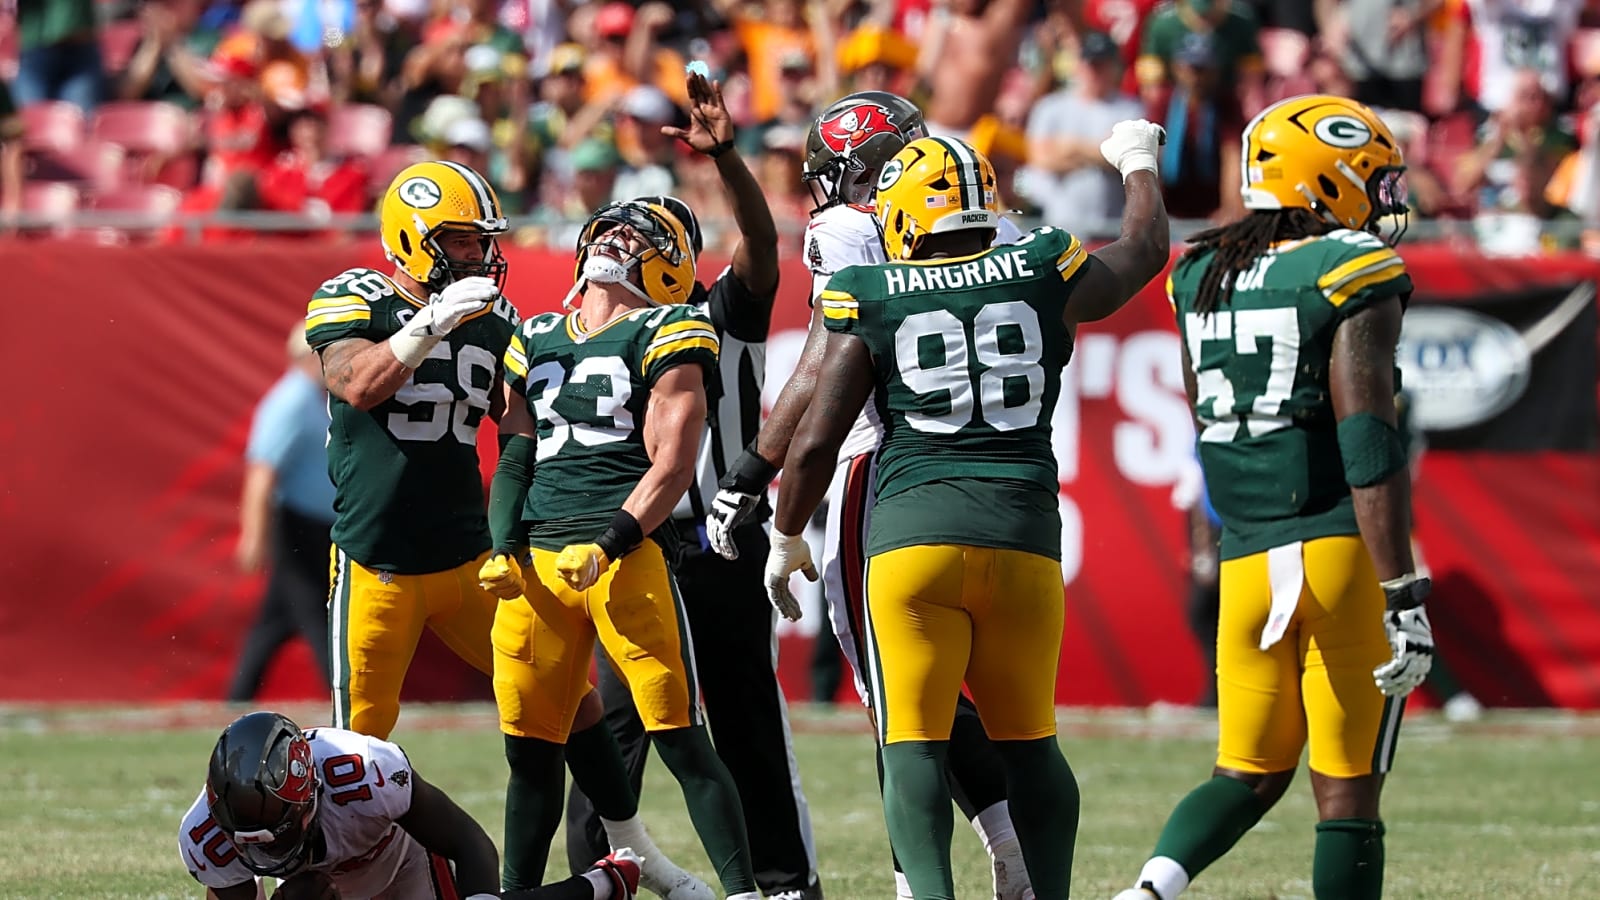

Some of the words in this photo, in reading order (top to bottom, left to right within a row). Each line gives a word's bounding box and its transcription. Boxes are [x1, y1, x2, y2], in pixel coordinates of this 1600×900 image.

[961, 213, 989, 224] PACKERS
[884, 249, 1034, 295] HARGRAVE
[387, 341, 497, 446] 58
[895, 300, 1046, 434] 98
[1185, 307, 1300, 443] 57
[525, 356, 635, 462] 33
[322, 753, 373, 807] 10
[189, 812, 239, 868] 10
